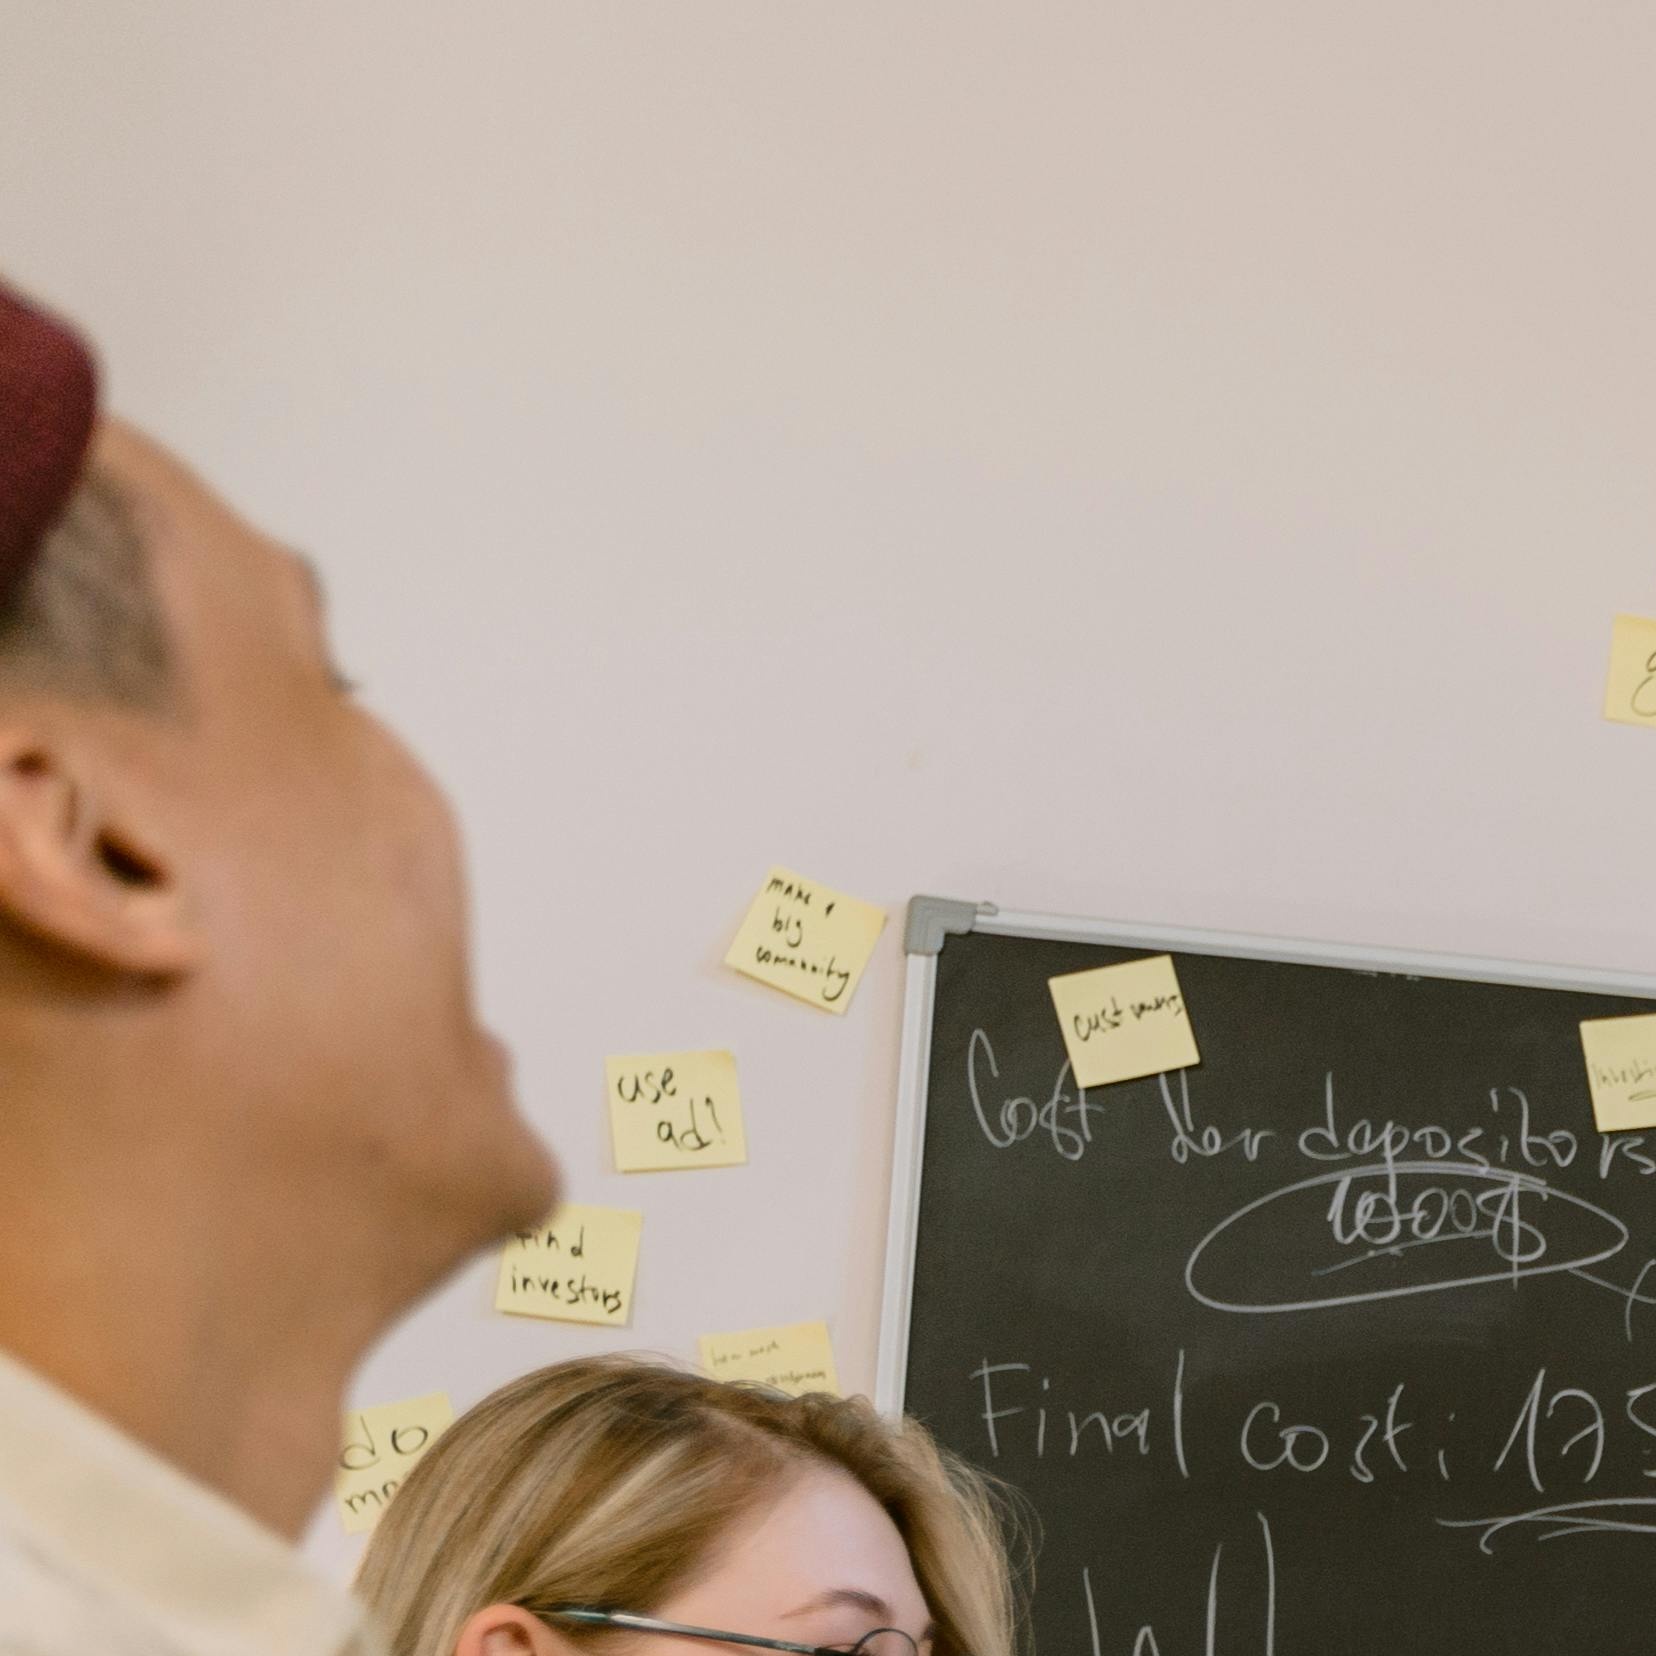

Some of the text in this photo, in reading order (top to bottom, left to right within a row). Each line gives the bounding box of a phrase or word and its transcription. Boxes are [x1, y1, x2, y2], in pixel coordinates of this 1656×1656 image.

[772, 906, 803, 948] big
[617, 1067, 677, 1104] use
[657, 1096, 726, 1151] ad!
[511, 1264, 622, 1314] investors
[969, 1349, 1190, 1479] Final
[341, 1415, 429, 1470] do
